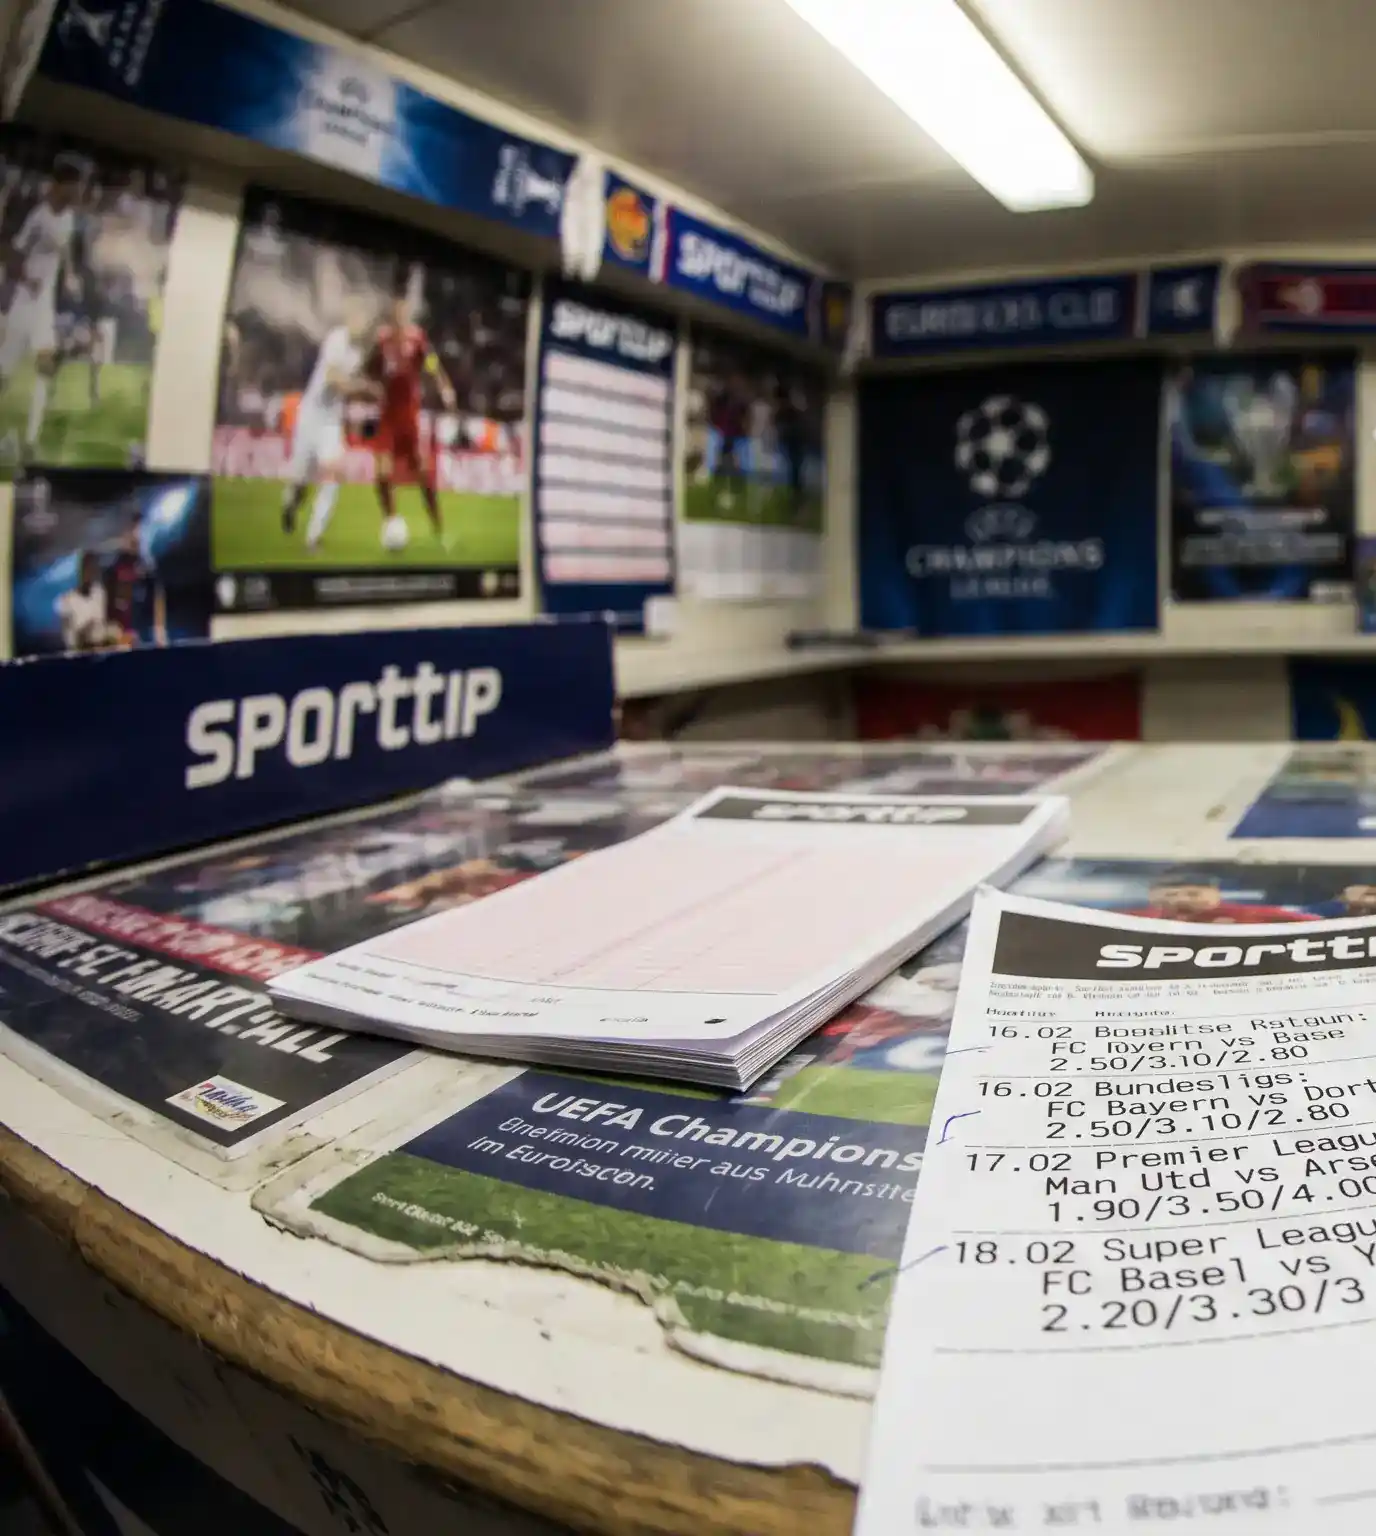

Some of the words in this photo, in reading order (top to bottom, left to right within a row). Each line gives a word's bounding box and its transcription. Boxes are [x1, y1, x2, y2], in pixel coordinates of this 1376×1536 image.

[989, 1026, 1073, 1039] 16.02
[1052, 1041, 1086, 1055] FC
[1221, 1036, 1255, 1048] vs
[1273, 1029, 1345, 1044] Base
[1050, 1045, 1308, 1072] 2.50/3.10/2.80
[978, 1082, 1073, 1097] 16.02
[1047, 1100, 1086, 1118] FC
[1107, 1096, 1230, 1117] Bayern
[1248, 1092, 1288, 1106] vs
[532, 1092, 645, 1130] UEFA
[650, 1114, 925, 1172] Champions
[1046, 1102, 1350, 1139] 2.50/3.10/2.80
[710, 1161, 771, 1181] aus
[967, 1152, 1072, 1172] 17.02
[1096, 1145, 1249, 1170] Premier
[1045, 1176, 1117, 1196] Man
[1141, 1167, 1211, 1191] Utd
[1235, 1166, 1280, 1184] vs
[955, 1240, 1075, 1264] 18.02
[1104, 1236, 1227, 1262] Super
[1042, 1270, 1092, 1295] FC
[1121, 1258, 1247, 1292] Basel
[1279, 1255, 1331, 1276] vs
